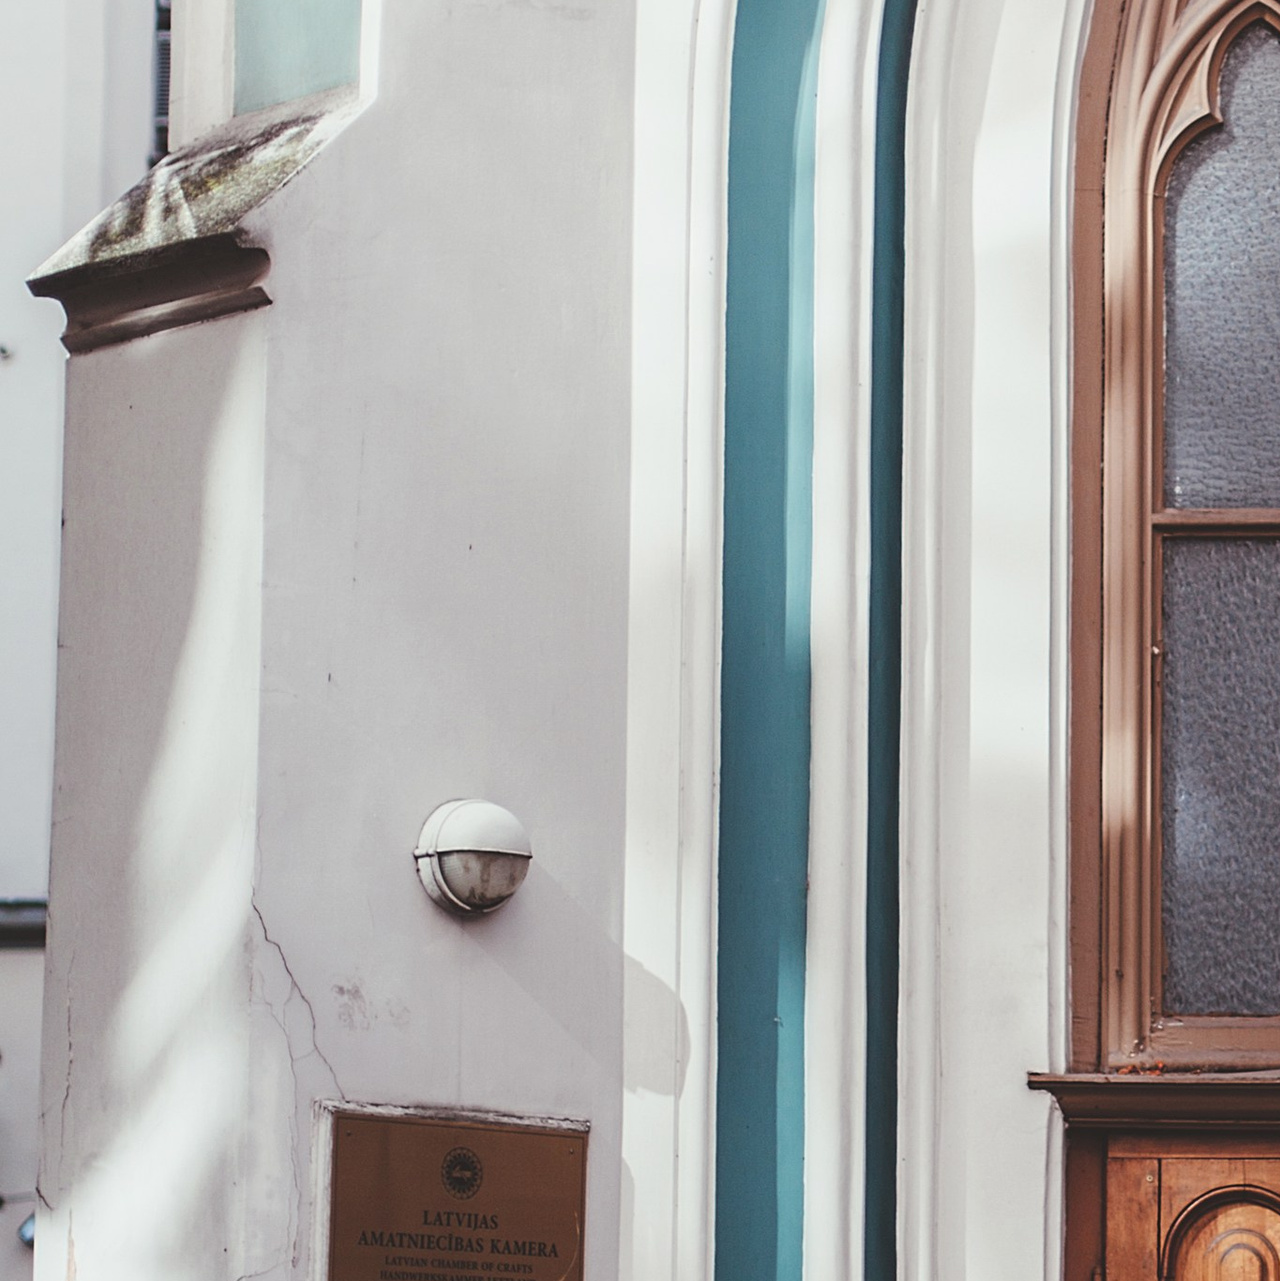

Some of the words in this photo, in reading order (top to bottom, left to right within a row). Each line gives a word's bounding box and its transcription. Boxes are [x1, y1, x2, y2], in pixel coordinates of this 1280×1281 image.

[422, 1210, 499, 1231] LATVIJAS
[358, 1230, 484, 1253] AMATNIECĪBAS
[490, 1238, 559, 1258] KAMERA
[385, 1255, 428, 1268] LATVIAN
[431, 1257, 478, 1270] CHAMBER
[481, 1261, 495, 1272] OF
[497, 1262, 533, 1274] CRAFTS
